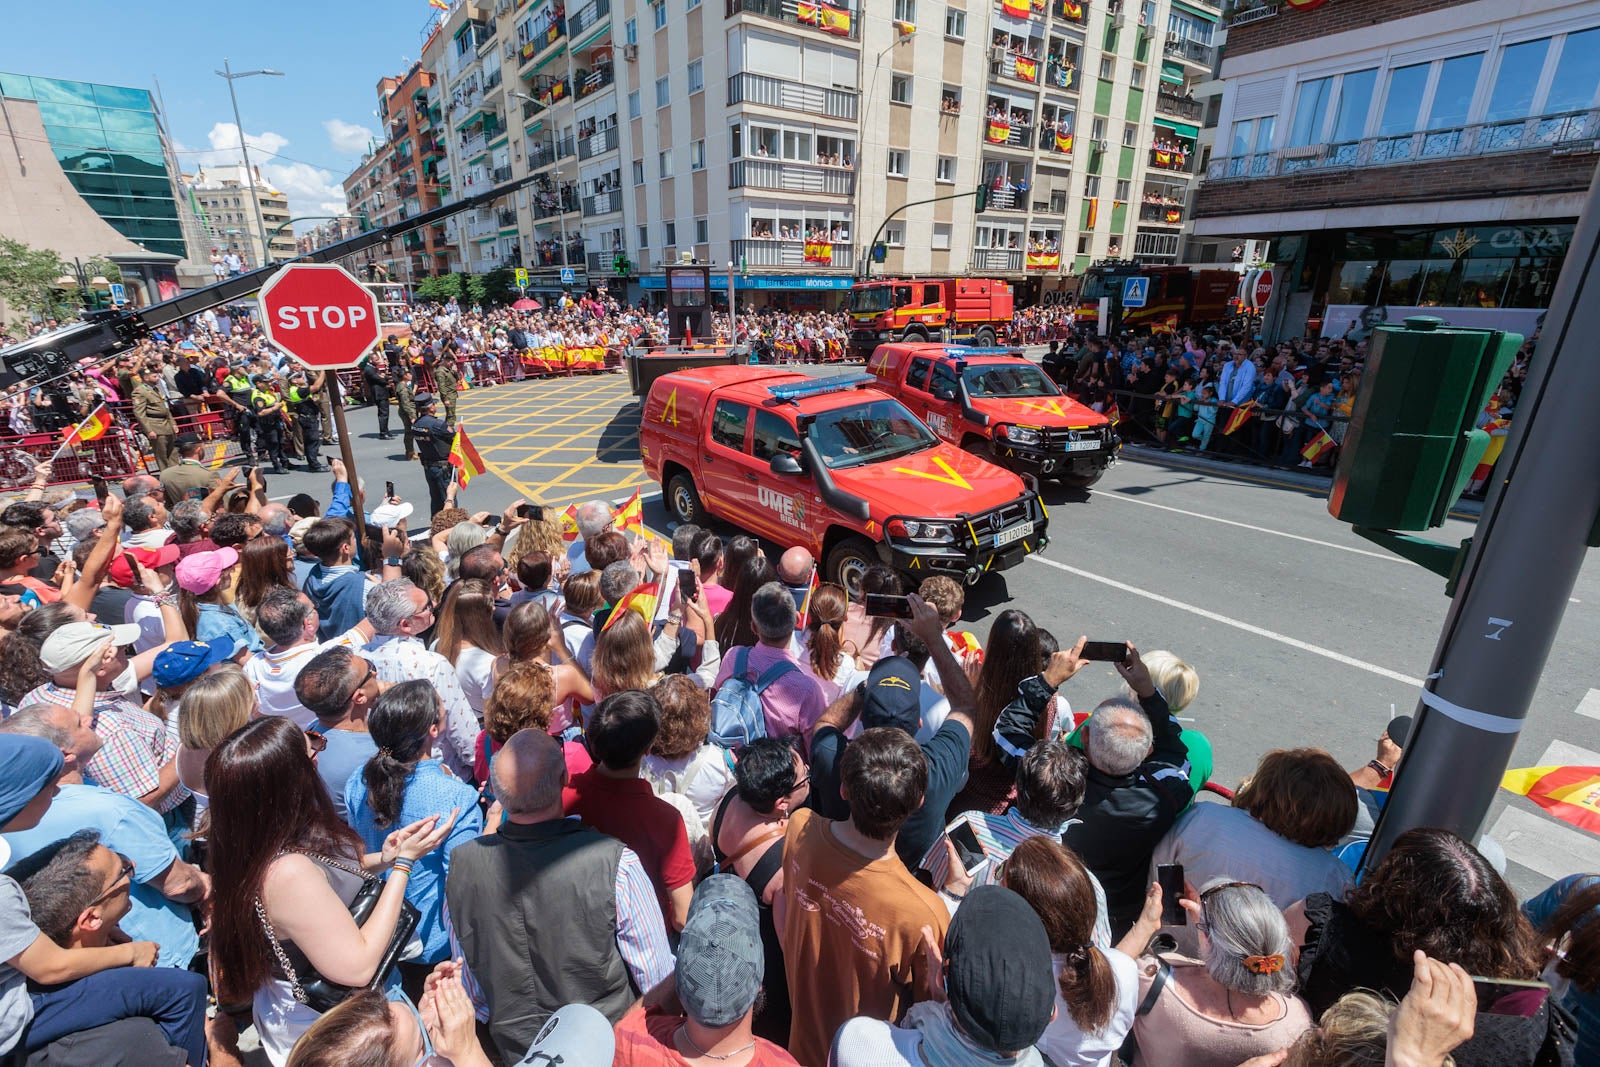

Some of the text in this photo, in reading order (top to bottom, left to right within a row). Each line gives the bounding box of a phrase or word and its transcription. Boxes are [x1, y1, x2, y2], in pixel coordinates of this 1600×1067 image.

[1257, 284, 1273, 294] STOP
[278, 306, 367, 330] STOP
[1070, 442, 1078, 451] ET
[757, 485, 794, 517] UME
[999, 532, 1007, 544] ET
[1484, 616, 1514, 641] 7
